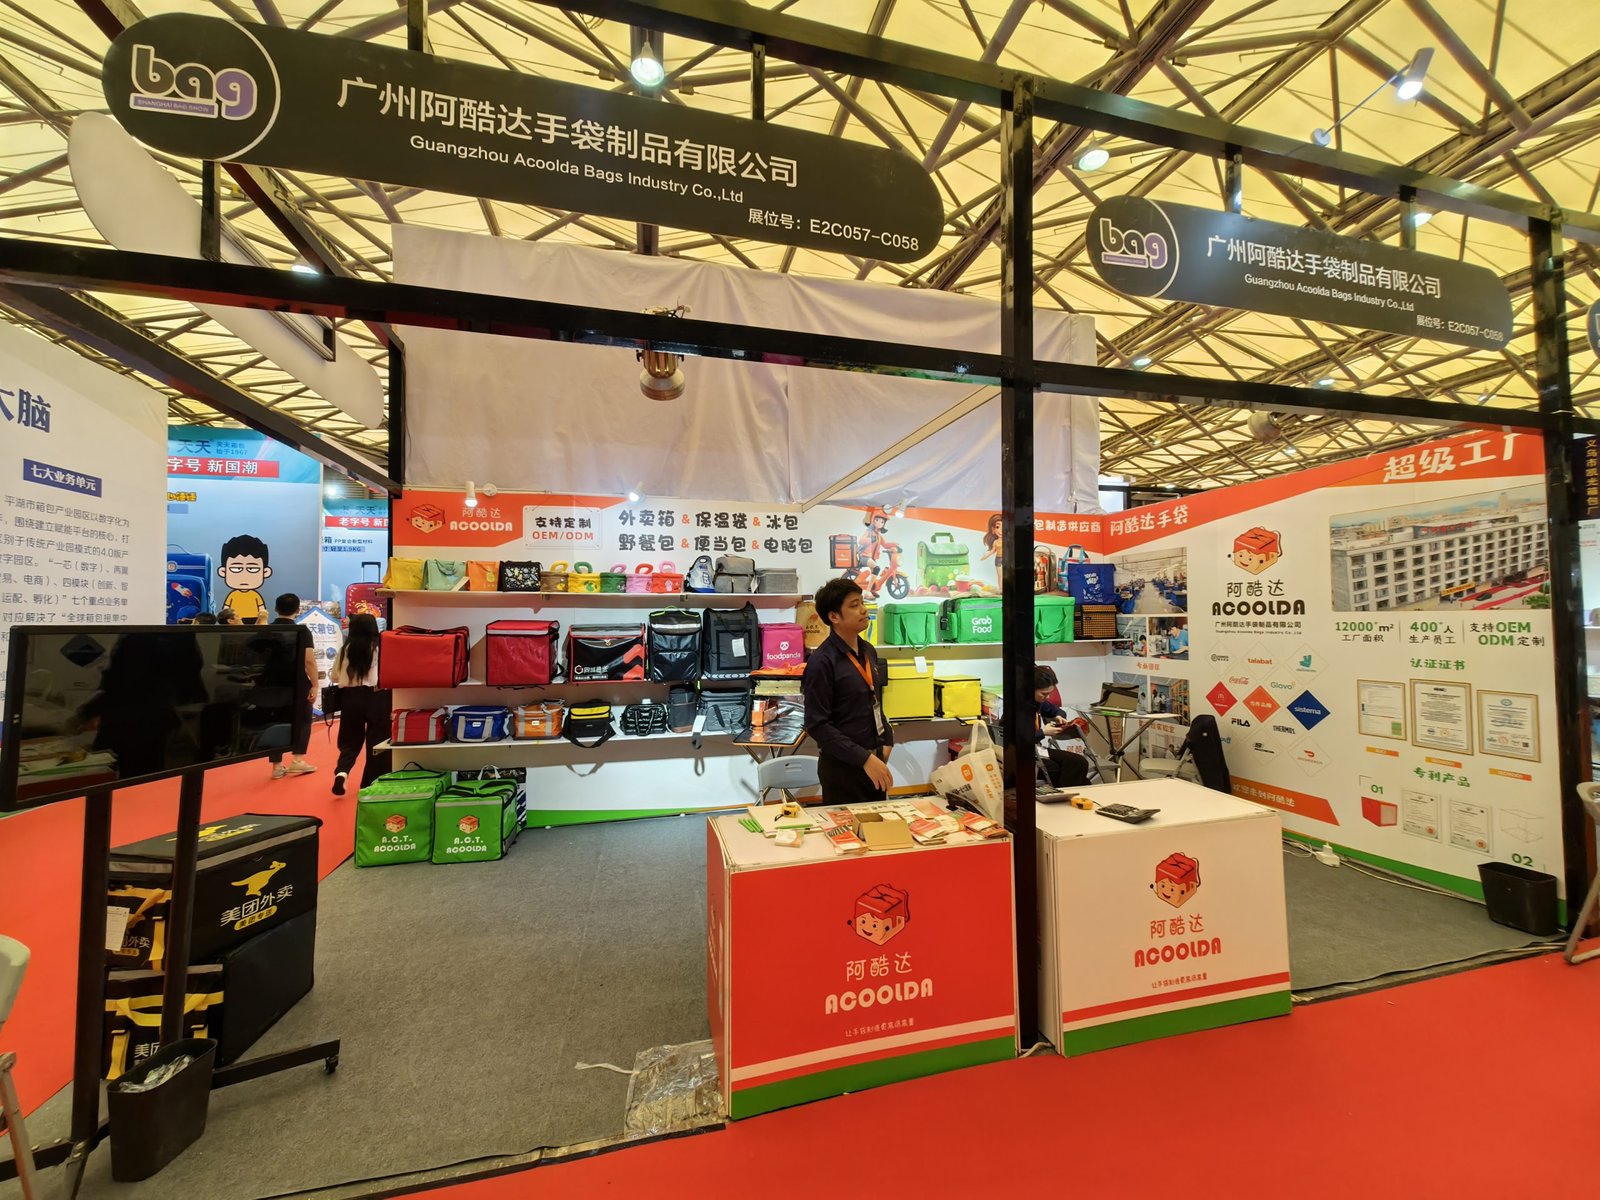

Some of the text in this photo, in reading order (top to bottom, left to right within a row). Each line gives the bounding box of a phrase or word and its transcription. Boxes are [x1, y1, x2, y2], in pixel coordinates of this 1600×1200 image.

[132, 44, 258, 120] bag
[137, 99, 173, 108] SHANGHAI
[174, 102, 187, 110] BAG
[337, 77, 797, 187] 广州阿酷达手袋制品有限公司
[410, 135, 743, 203] Guangzhou Acoolda Bags Industry Co.,Ltd
[1100, 218, 1167, 269] bag
[1207, 235, 1441, 298] 广州阿酷达手袋制品有限公司
[1244, 273, 1295, 291] Guangzhou
[1297, 282, 1330, 297] Acoolda
[1332, 288, 1353, 301] Bags
[1354, 292, 1386, 306] Industry
[1383, 433, 1520, 483] 超级工厂
[208, 460, 258, 474] 新国潮
[31, 464, 96, 491] 七大业务单元
[462, 507, 501, 518] 阿酷达
[618, 509, 798, 530] 外卖箱 & 保温袋 & 冰包
[1110, 504, 1188, 536] 阿酷达手袋
[340, 517, 369, 527] 老字号
[450, 521, 513, 531] ACOOLDA
[535, 516, 591, 528] 支持定制
[532, 531, 594, 540] OEM/ODM
[618, 533, 813, 553] 野餐包 & 便当包 & 电脑包
[1227, 579, 1285, 598] 阿酷达
[1212, 599, 1306, 616] ACOOLDA
[972, 616, 992, 625] Grab
[972, 624, 992, 633] Food
[1341, 634, 1385, 642] 工厂面积
[1409, 634, 1456, 644] 生产员工
[767, 652, 801, 661] foodpanda
[1410, 658, 1465, 670] 认证证书
[1270, 681, 1293, 690] Glovo
[1294, 706, 1321, 715] sistema
[1231, 717, 1251, 727] FILA
[1413, 767, 1471, 787] 专利产品
[1371, 784, 1384, 794] 01
[374, 843, 416, 853] ACOOLDA
[446, 845, 487, 854] ACOOLDA
[1512, 853, 1533, 868] 02
[220, 884, 293, 927] 美团外卖
[1150, 913, 1204, 939] 阿酷达
[1134, 937, 1221, 968] ACOOLDA
[846, 952, 912, 982] 阿酷达
[825, 978, 933, 1015] ACOOLDA
